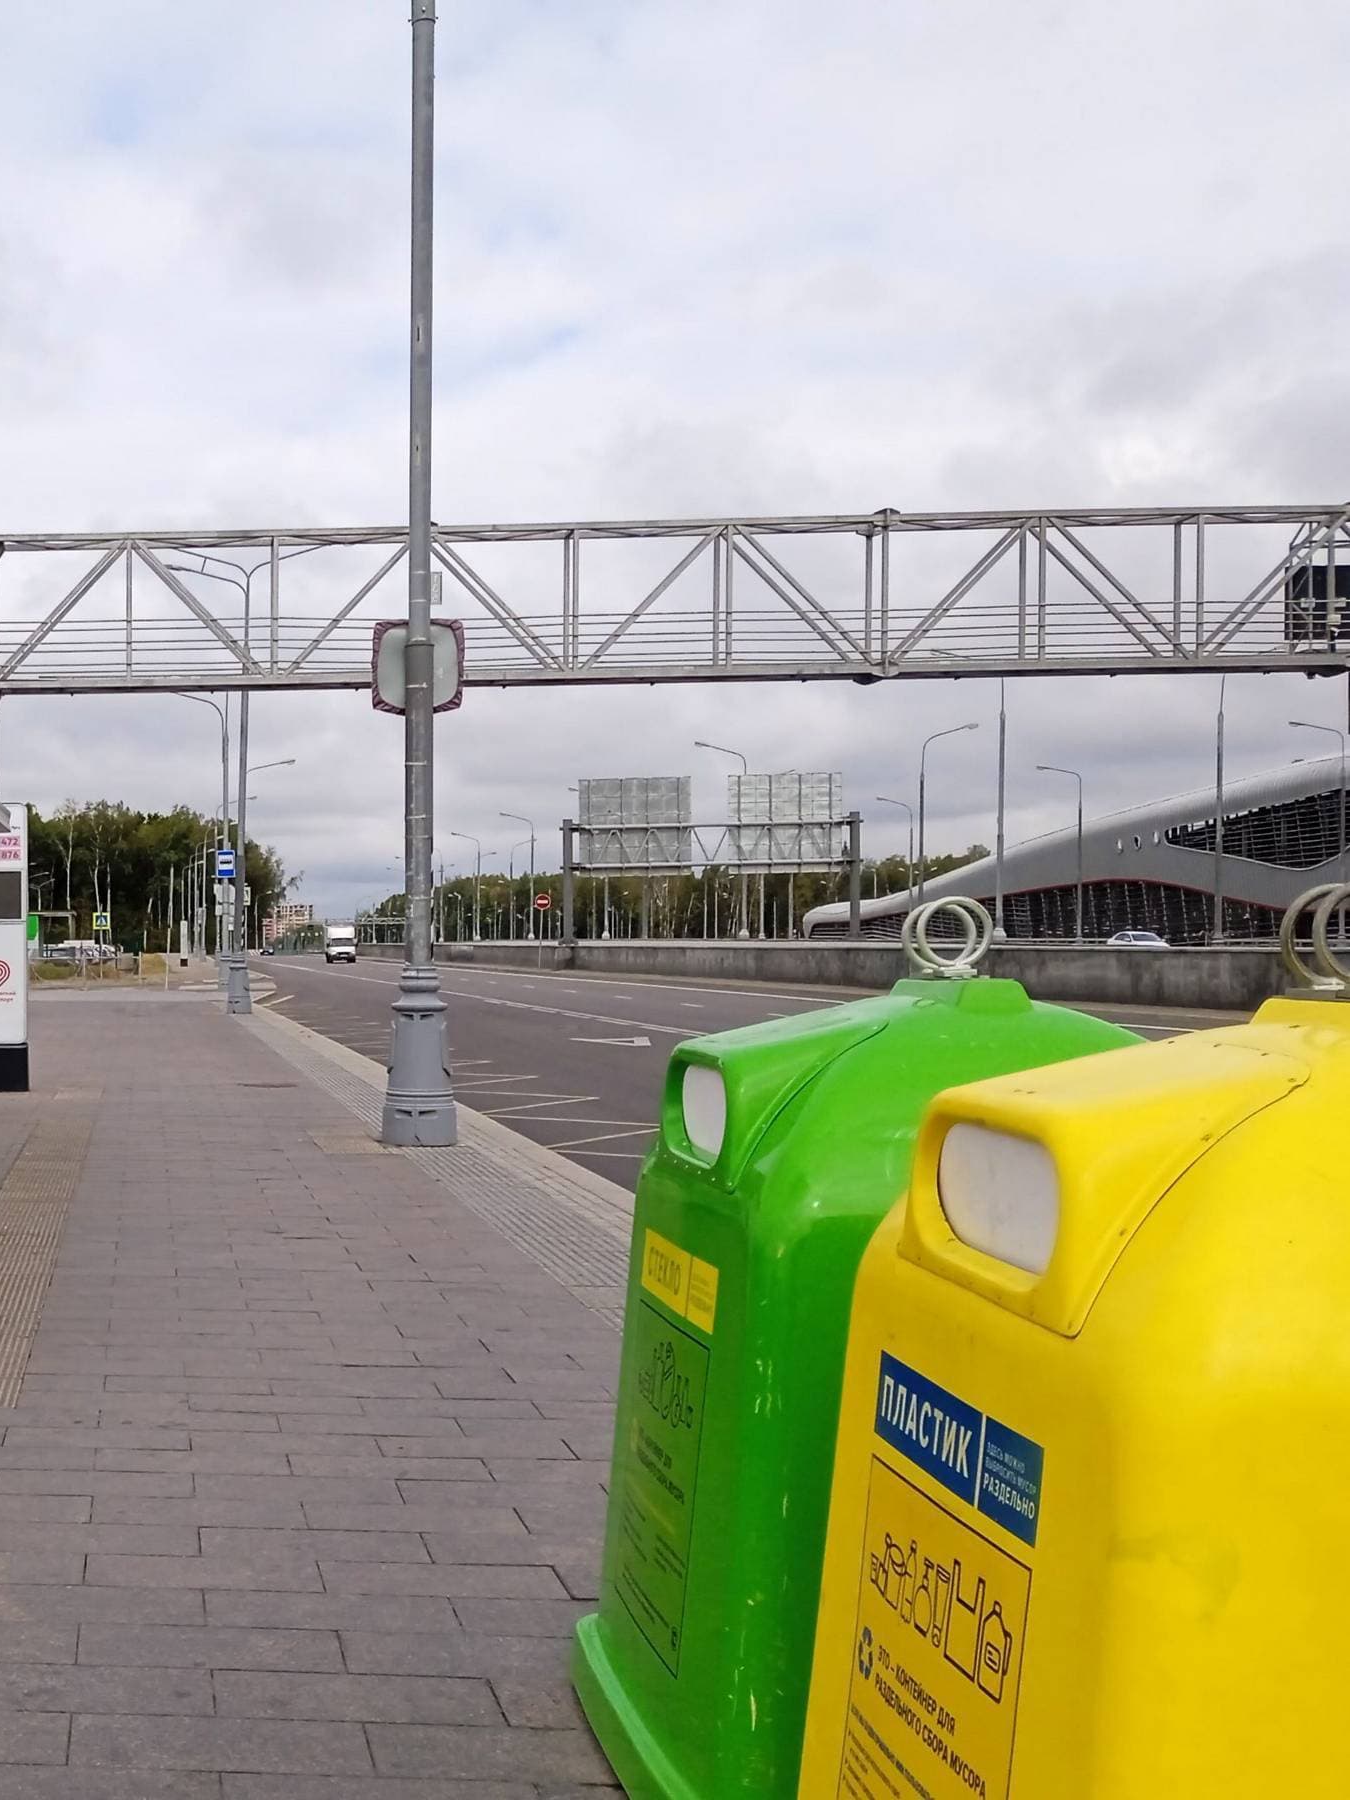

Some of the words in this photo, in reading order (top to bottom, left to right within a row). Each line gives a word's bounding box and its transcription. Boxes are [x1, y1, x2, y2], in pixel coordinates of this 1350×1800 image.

[1, 838, 19, 846] 472
[2, 851, 19, 859] 876
[648, 1246, 681, 1295] СТЕКЛО
[881, 1375, 972, 1478] ПЛАСТИК
[1004, 1452, 1025, 1474] МОЖНО
[1017, 1475, 1037, 1494] МУСОР
[983, 1473, 1035, 1519] РАЗДЕЛЬНО
[878, 1645, 890, 1671] ЭТО
[895, 1665, 937, 1715] КОНТЕЙНЕР
[937, 1706, 956, 1736] ДЛЯ
[875, 1673, 922, 1736] РАЗДЕЛЬНОГО
[922, 1724, 948, 1764] СБОРА
[950, 1751, 986, 1799] МУСОРА
